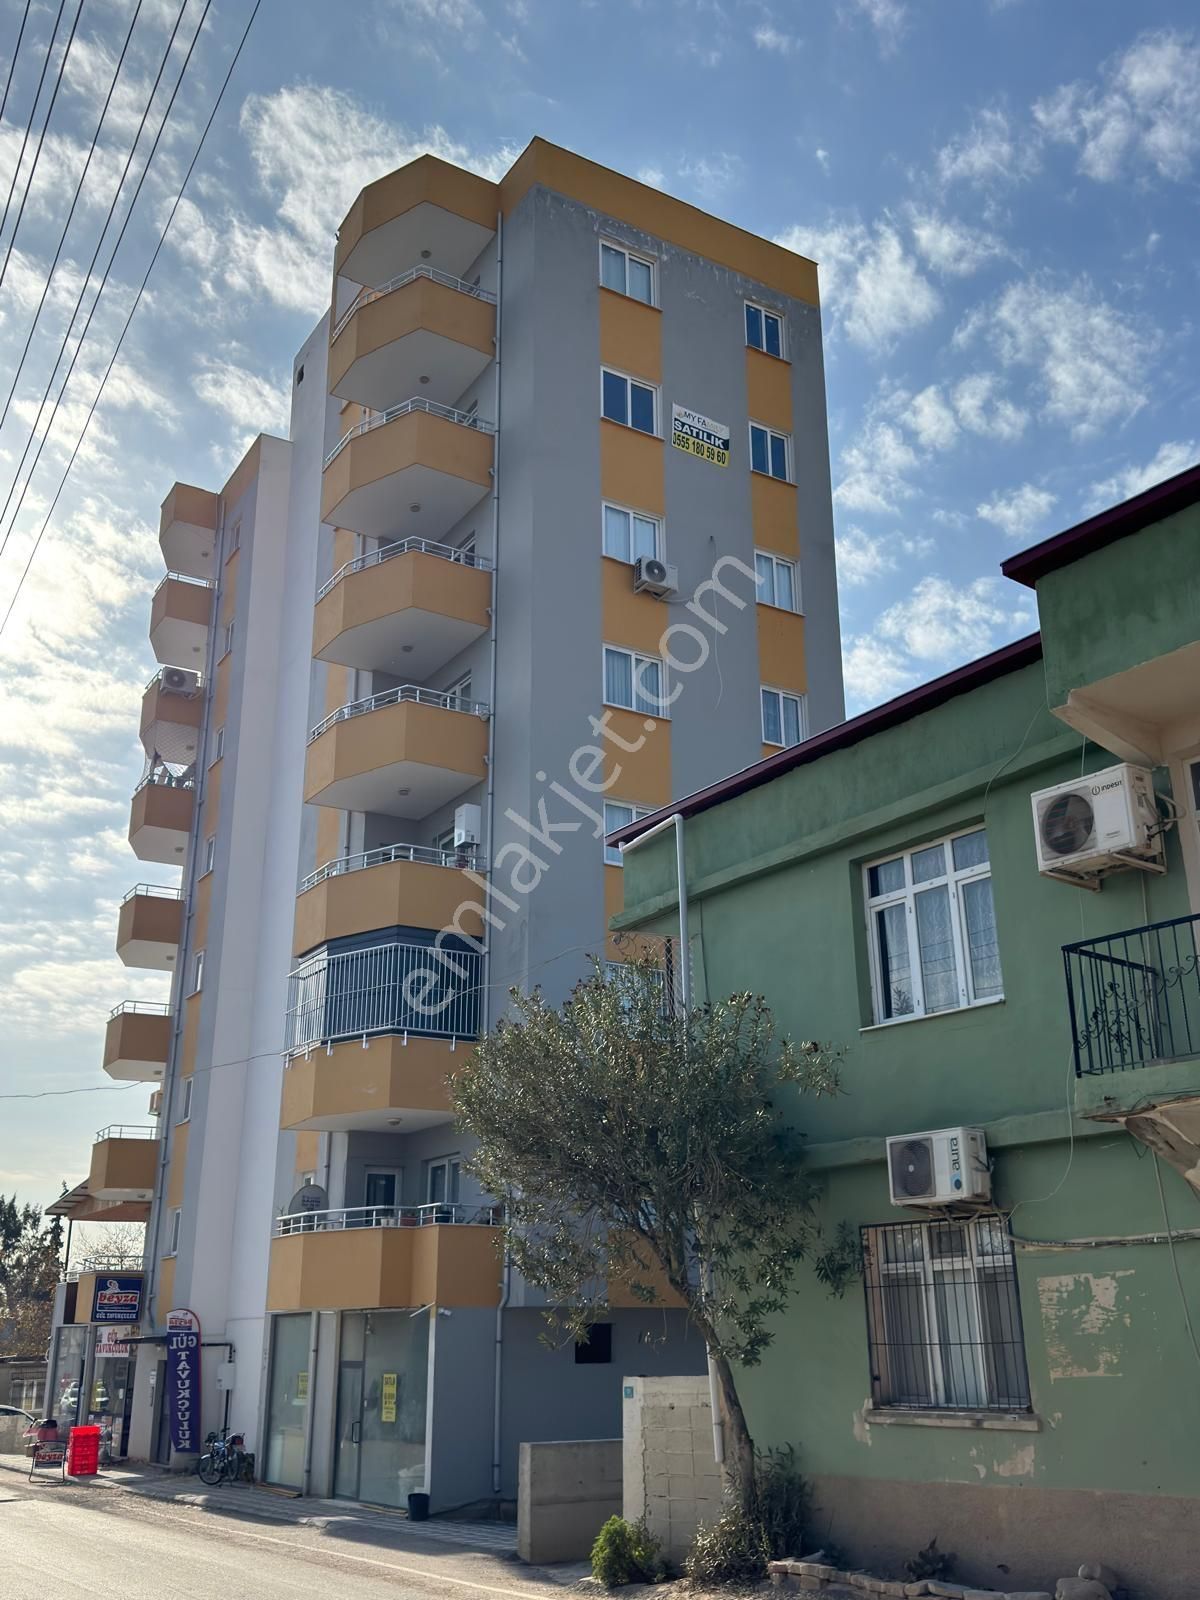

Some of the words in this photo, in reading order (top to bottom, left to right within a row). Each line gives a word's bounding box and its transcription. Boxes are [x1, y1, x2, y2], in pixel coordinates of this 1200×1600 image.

[684, 411, 696, 422] MY
[674, 420, 724, 449] SATILIK
[692, 440, 705, 456] 180
[706, 446, 716, 460] 59
[716, 450, 726, 464] 60
[950, 1137, 961, 1171] aura
[99, 1292, 138, 1304] beyza
